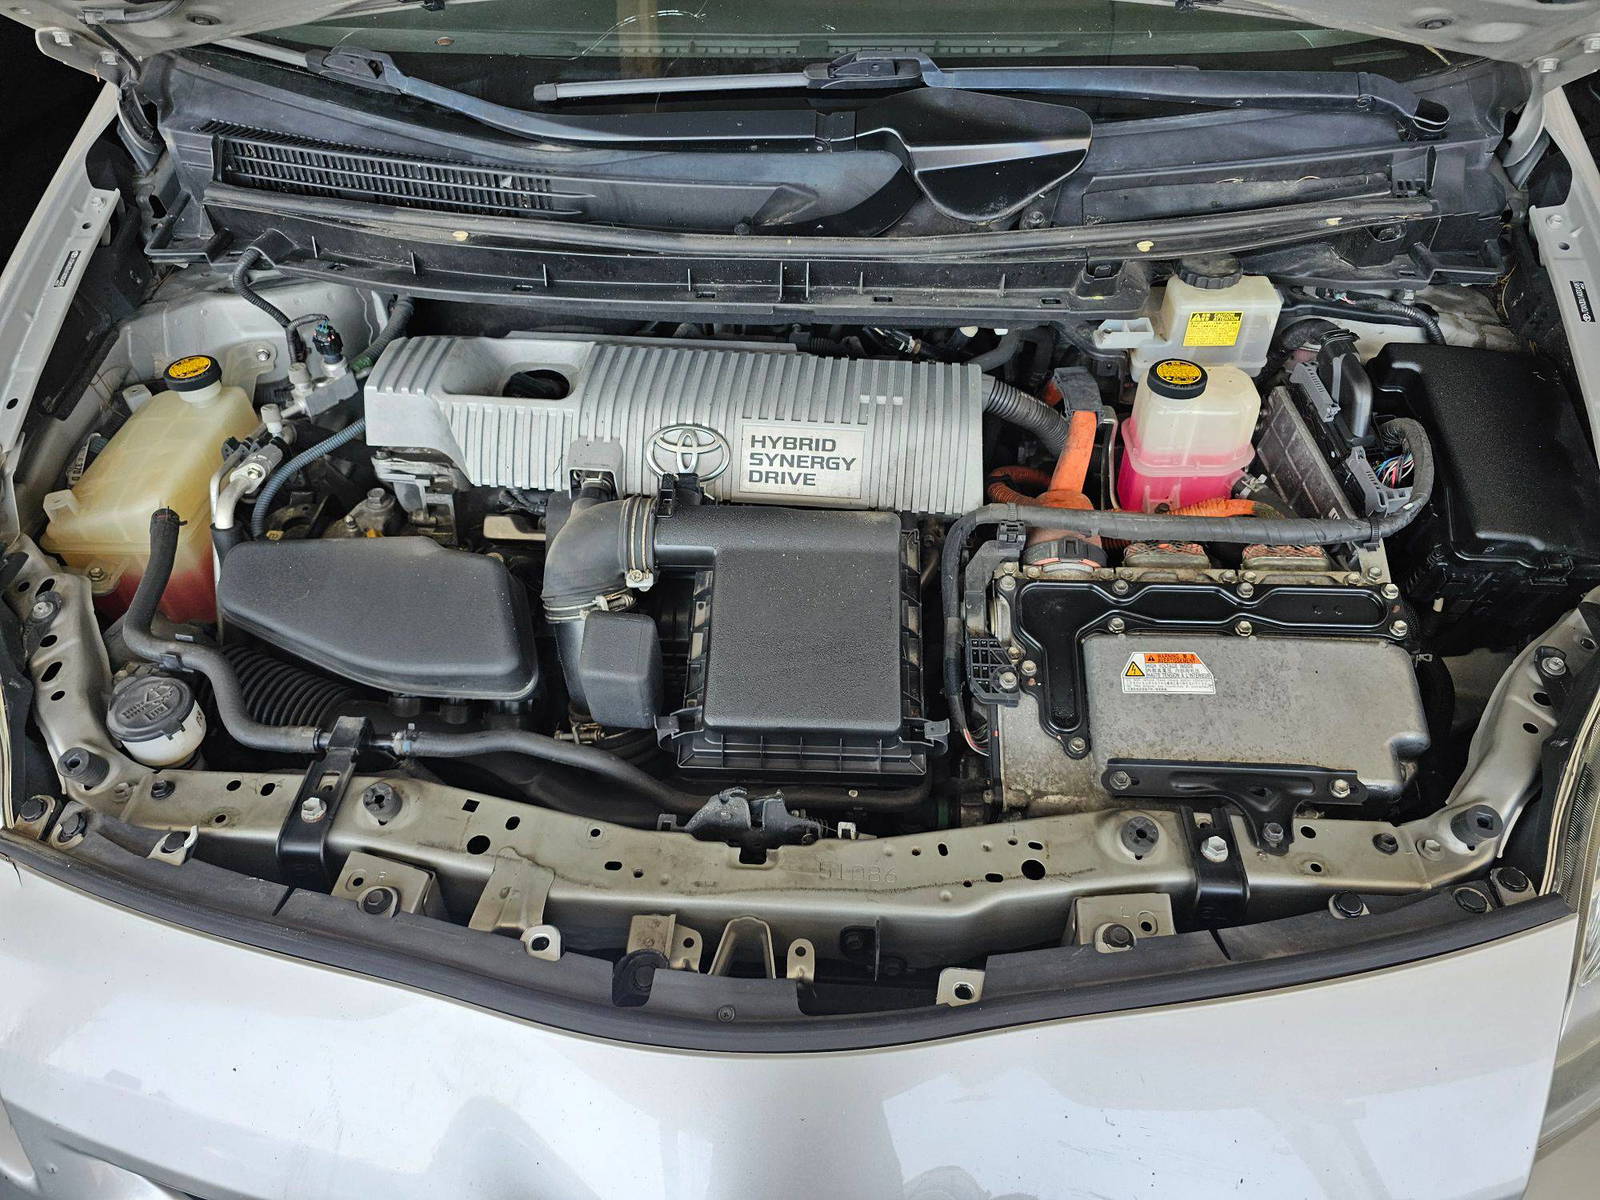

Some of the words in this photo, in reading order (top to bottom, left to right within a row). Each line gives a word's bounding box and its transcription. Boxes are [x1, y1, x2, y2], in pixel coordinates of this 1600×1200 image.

[751, 435, 837, 452] HYBRID
[749, 453, 857, 471] SYNERGY
[749, 470, 817, 487] DRIVE
